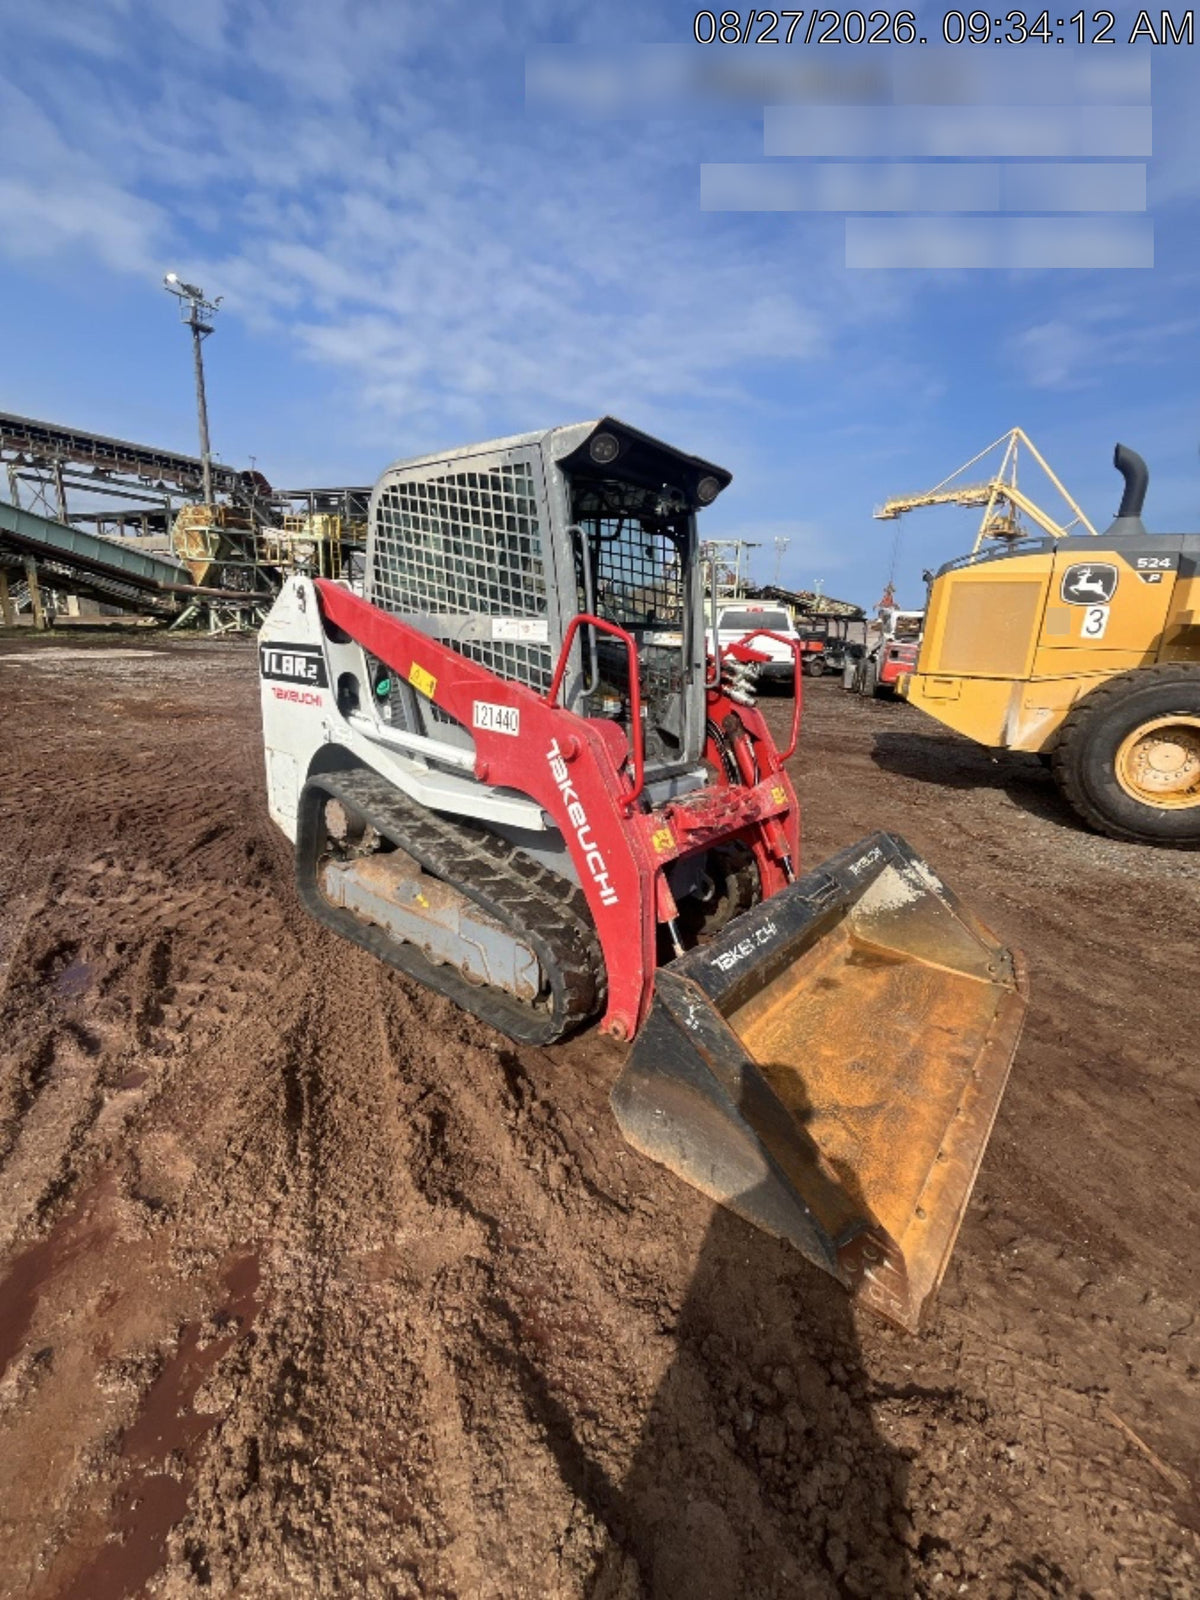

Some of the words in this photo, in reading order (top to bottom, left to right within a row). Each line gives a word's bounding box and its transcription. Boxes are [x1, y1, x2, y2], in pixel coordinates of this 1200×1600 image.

[1137, 558, 1171, 568] 524
[1148, 573, 1160, 583] P
[1086, 609, 1104, 635] 3
[475, 704, 518, 732] 121440
[546, 737, 619, 906] TAKEUCHI
